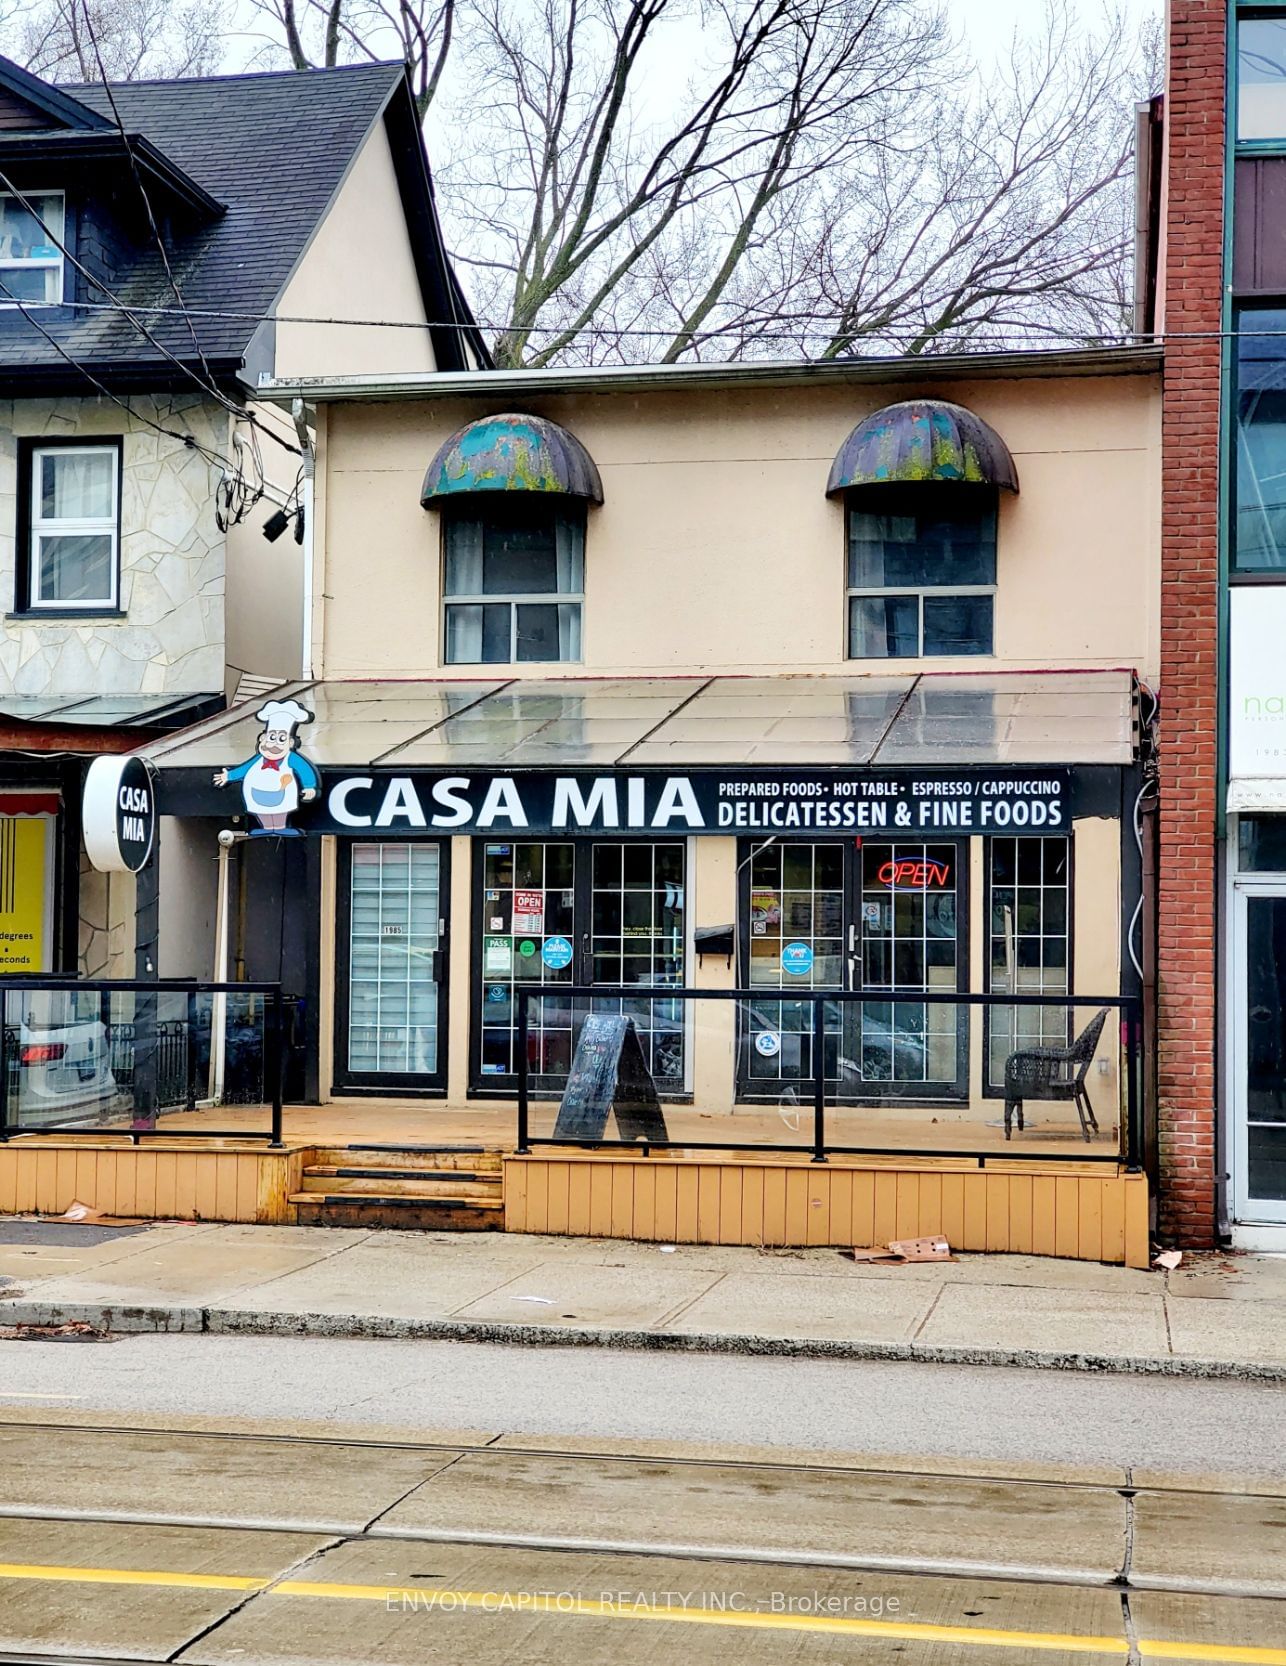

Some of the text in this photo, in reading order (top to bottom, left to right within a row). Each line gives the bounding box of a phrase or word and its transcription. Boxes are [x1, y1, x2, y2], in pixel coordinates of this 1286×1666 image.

[119, 785, 148, 813] CASA
[719, 782, 780, 796] PREPARED
[833, 782, 859, 796] HOT
[861, 782, 898, 796] TABLE
[912, 781, 972, 796] ESPRESSO
[982, 780, 1061, 795] CAPPUCCINO
[328, 777, 706, 827] CASA MIA
[718, 800, 1062, 827] DELICATESSEN & FINE FOODS
[122, 815, 145, 842] MIA
[878, 862, 949, 886] OPEN
[517, 896, 542, 907] OPEN
[489, 939, 508, 947] PASS
